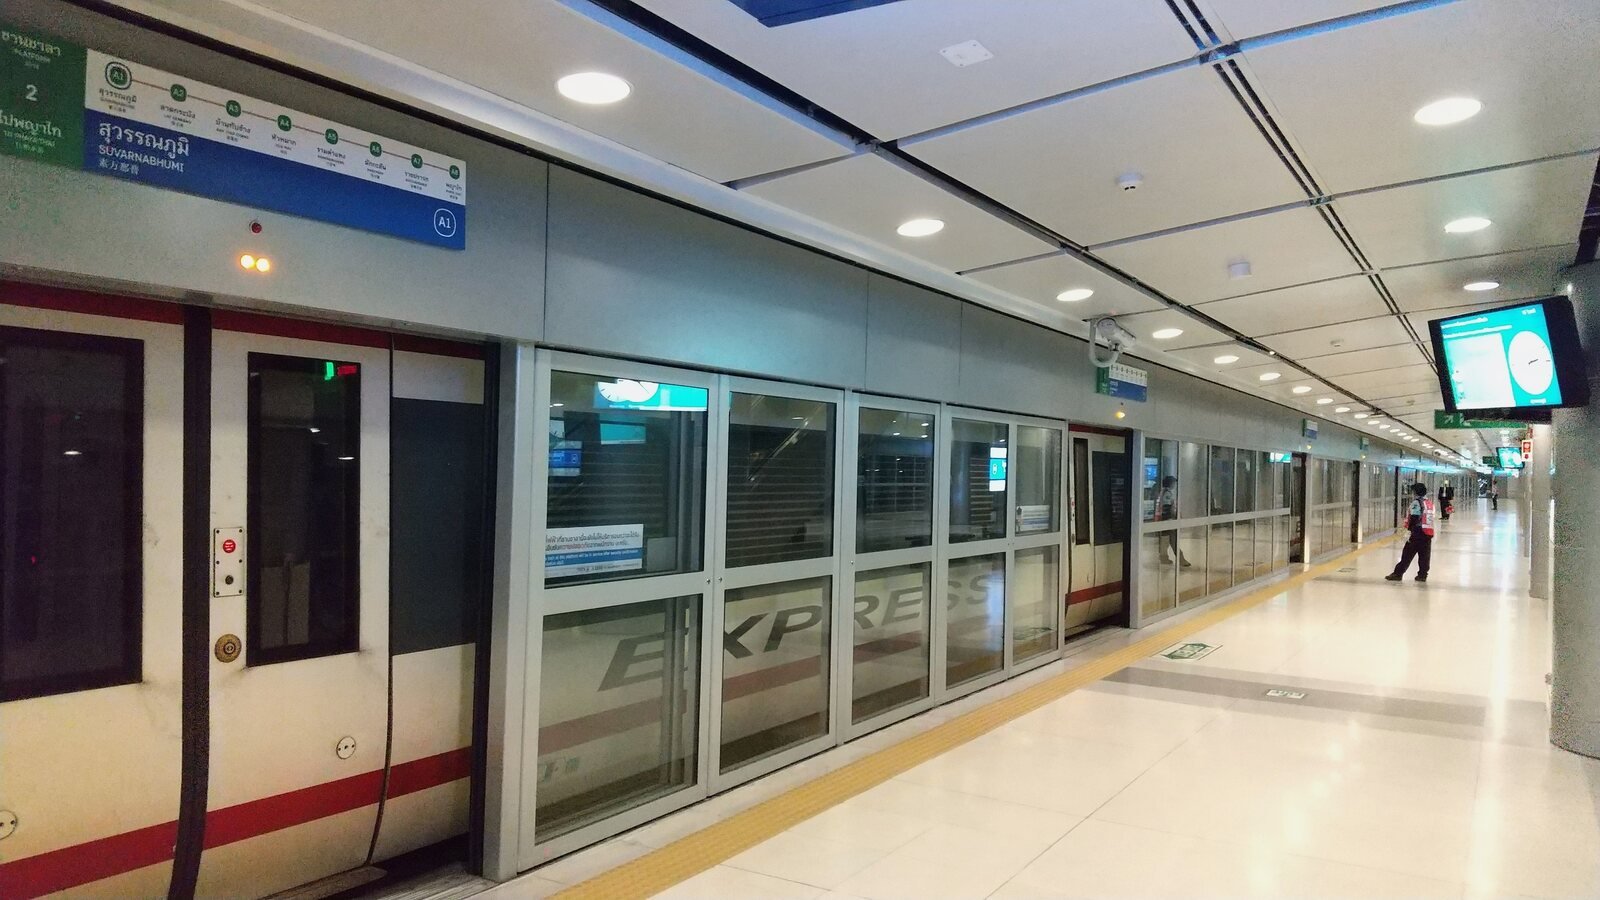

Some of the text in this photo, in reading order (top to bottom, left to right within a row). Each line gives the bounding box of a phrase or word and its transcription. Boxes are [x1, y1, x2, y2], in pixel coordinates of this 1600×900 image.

[112, 70, 125, 81] A1
[26, 84, 37, 101] 2
[173, 88, 185, 99] A2
[229, 102, 240, 114] A3
[280, 118, 290, 128] A4
[99, 123, 189, 159] สุวรรณภูมิ
[99, 144, 184, 172] SUVARNABHUMI
[438, 216, 452, 229] A1
